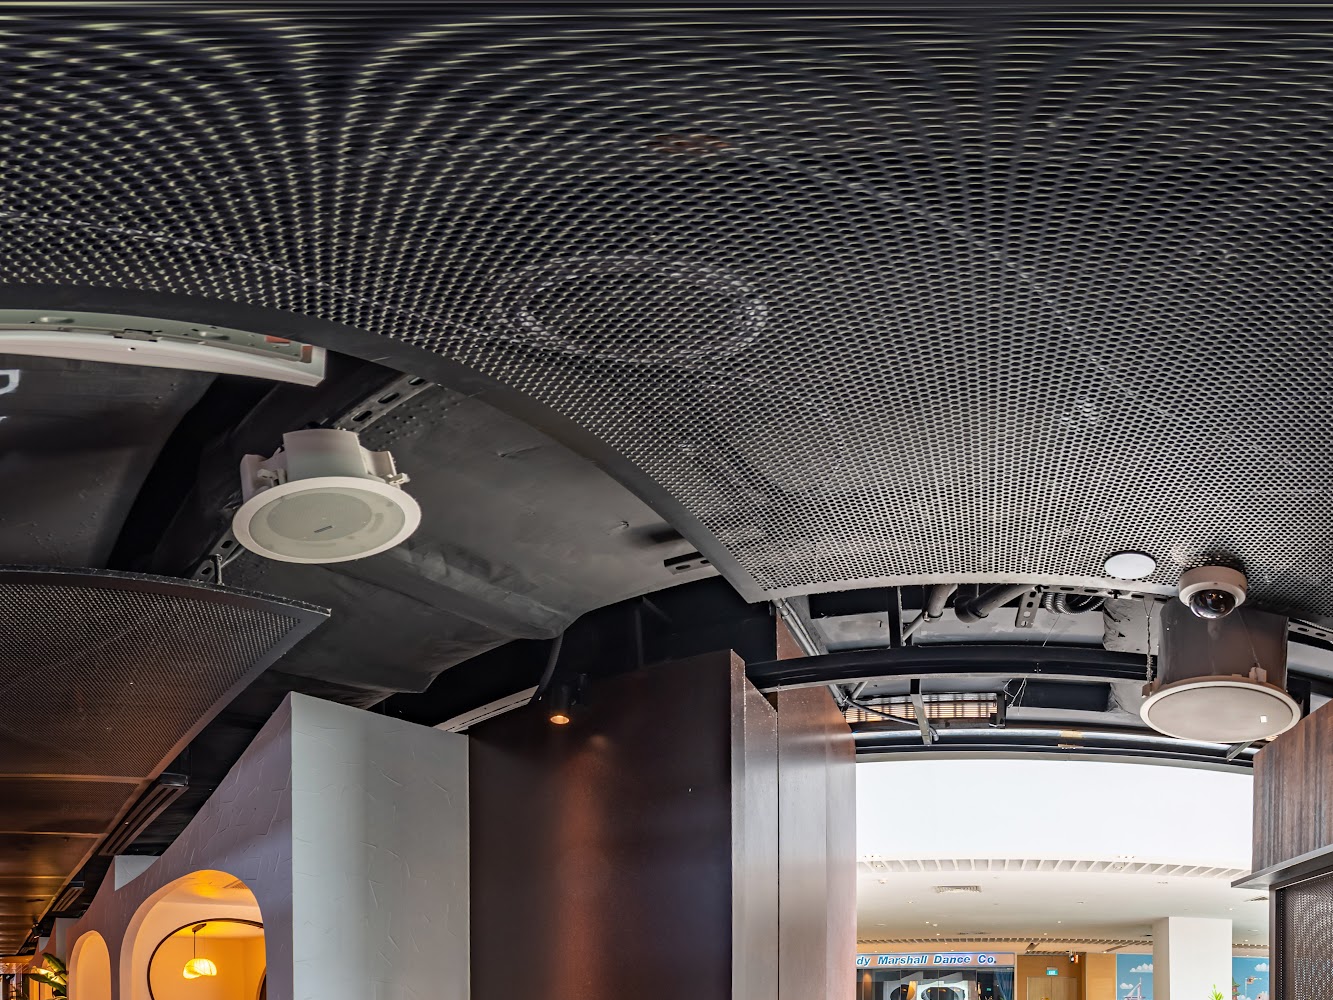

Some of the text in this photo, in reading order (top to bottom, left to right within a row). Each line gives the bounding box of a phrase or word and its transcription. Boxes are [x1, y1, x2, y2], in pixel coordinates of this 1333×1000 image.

[877, 955, 928, 965] Marshall
[933, 954, 971, 964] Dance
[978, 954, 997, 964] Co.
